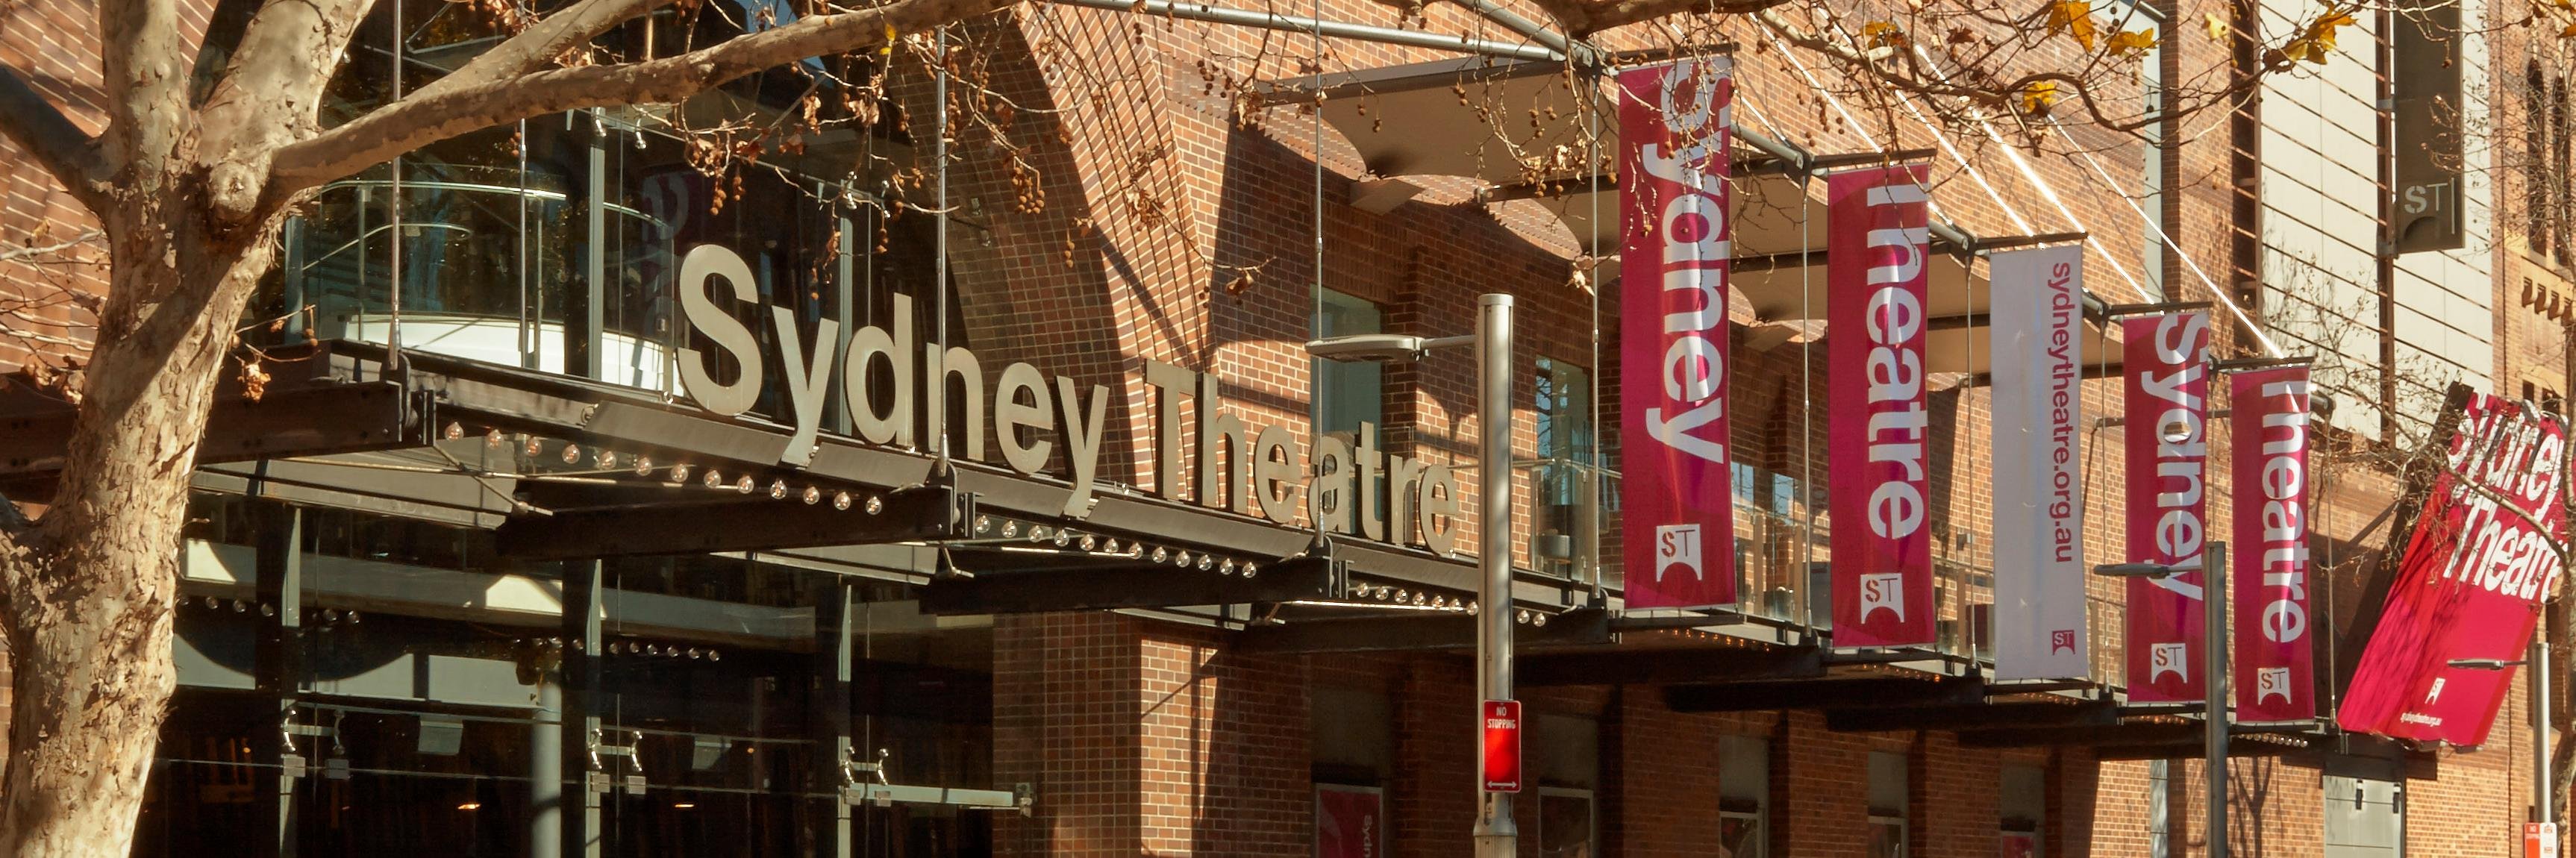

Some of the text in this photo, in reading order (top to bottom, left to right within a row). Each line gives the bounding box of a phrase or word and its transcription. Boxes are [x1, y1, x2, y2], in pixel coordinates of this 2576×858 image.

[2404, 182, 2448, 214] ST
[675, 244, 1460, 555] Sydney Theatre
[2048, 262, 2075, 563] sydneytheatre.org.au
[2141, 313, 2209, 601] Sydney
[1661, 529, 1696, 558] ST
[1866, 577, 1898, 603] ST
[2054, 631, 2072, 645] ST
[2155, 646, 2182, 666] ST
[2262, 671, 2286, 689] ST
[1487, 718, 1516, 729] STOPPING
[1496, 706, 1507, 716] NO
